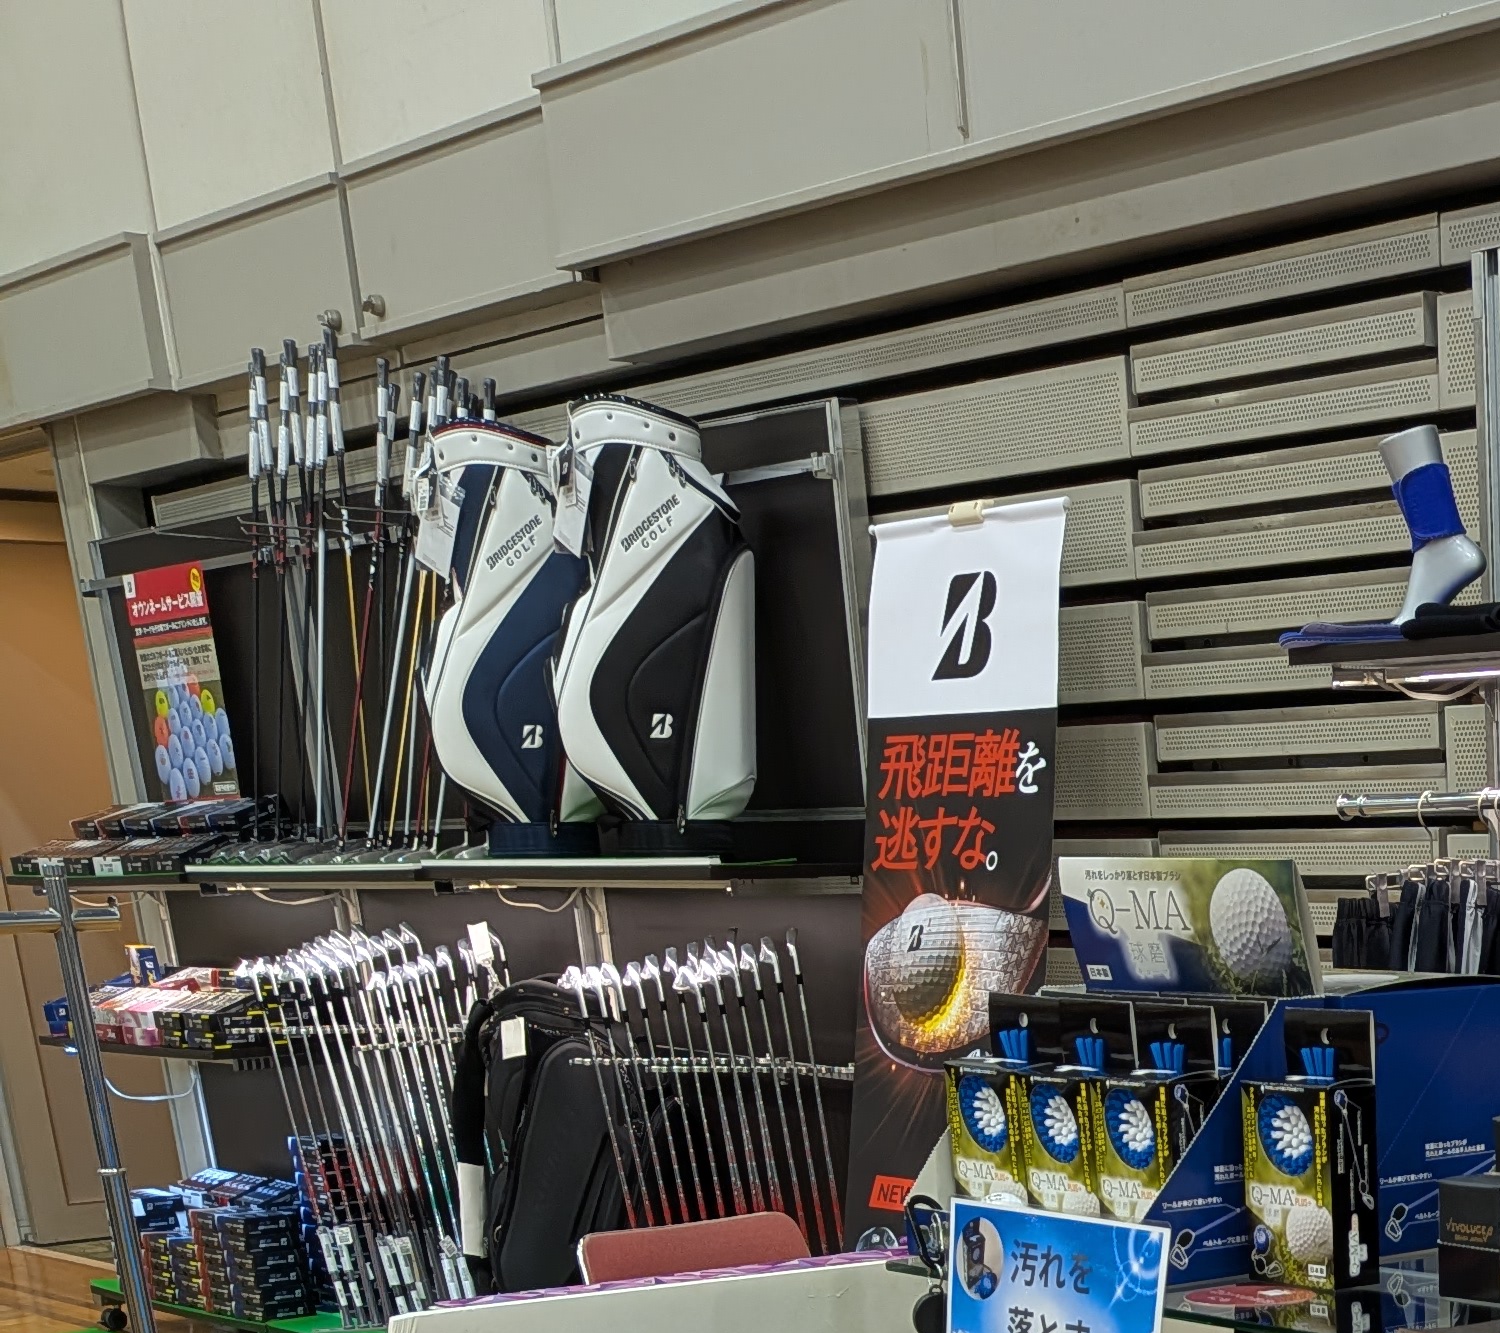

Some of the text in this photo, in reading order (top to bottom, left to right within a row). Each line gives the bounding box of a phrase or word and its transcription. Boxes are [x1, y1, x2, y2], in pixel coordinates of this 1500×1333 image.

[620, 493, 681, 553] BRIDGESTONE
[641, 515, 675, 550] GOLF
[485, 514, 543, 571] BRIDGESTONE
[506, 534, 537, 567] GOLF
[878, 728, 1047, 800] 飛距離を
[872, 806, 999, 873] 逃すな。
[1085, 869, 1181, 881] 汚れをしっかり落とす日本製ブラシ
[1087, 888, 1191, 935] Q-MA
[1089, 967, 1111, 979] 日本製
[957, 1160, 994, 1182] Q-MA
[1030, 1171, 1068, 1192] Q-MA
[1102, 1178, 1142, 1200] Q-MA
[1251, 1187, 1295, 1207] Q-MA
[1010, 1238, 1094, 1296] 汚れを
